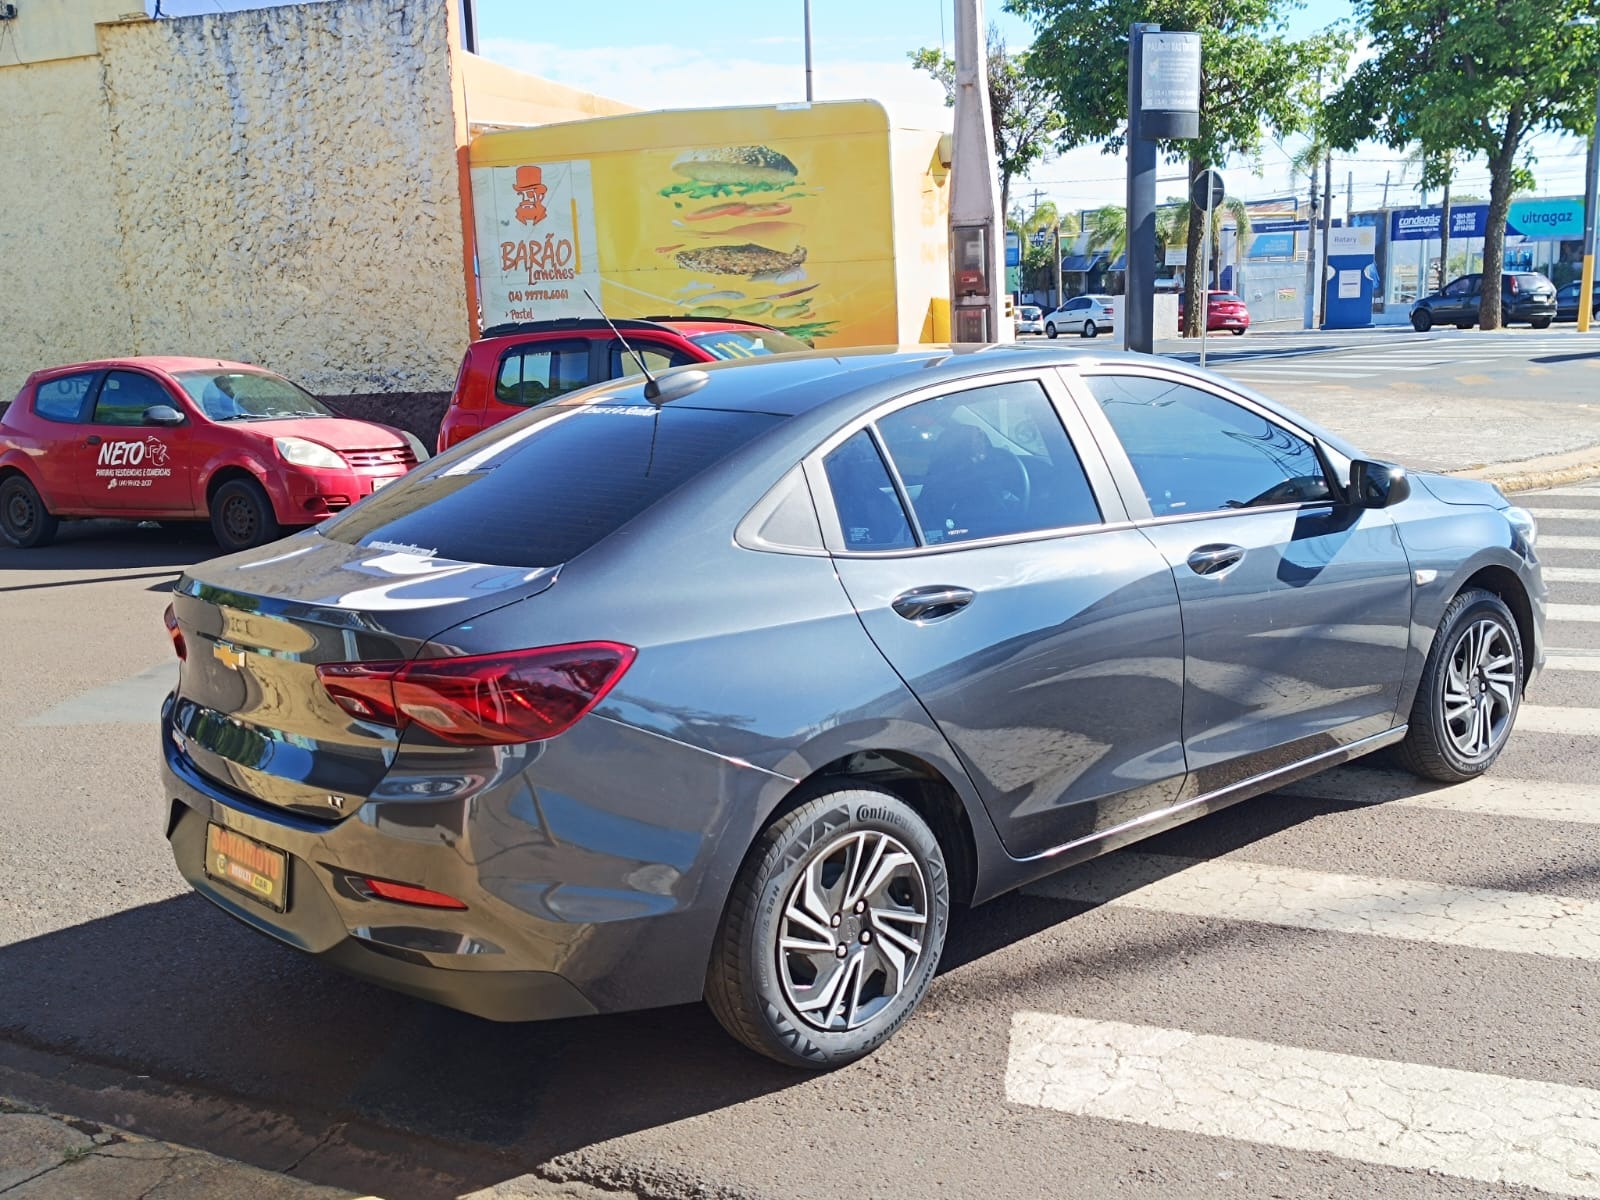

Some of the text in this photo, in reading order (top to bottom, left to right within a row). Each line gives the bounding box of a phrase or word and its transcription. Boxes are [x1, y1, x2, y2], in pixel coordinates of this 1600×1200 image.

[1521, 211, 1573, 226] ultragaz
[1334, 236, 1357, 244] Rotary
[501, 233, 572, 271] BARÃO
[528, 264, 575, 286] Lanches
[98, 441, 144, 465] NETO
[328, 795, 344, 808] LT
[856, 804, 922, 838] Continen
